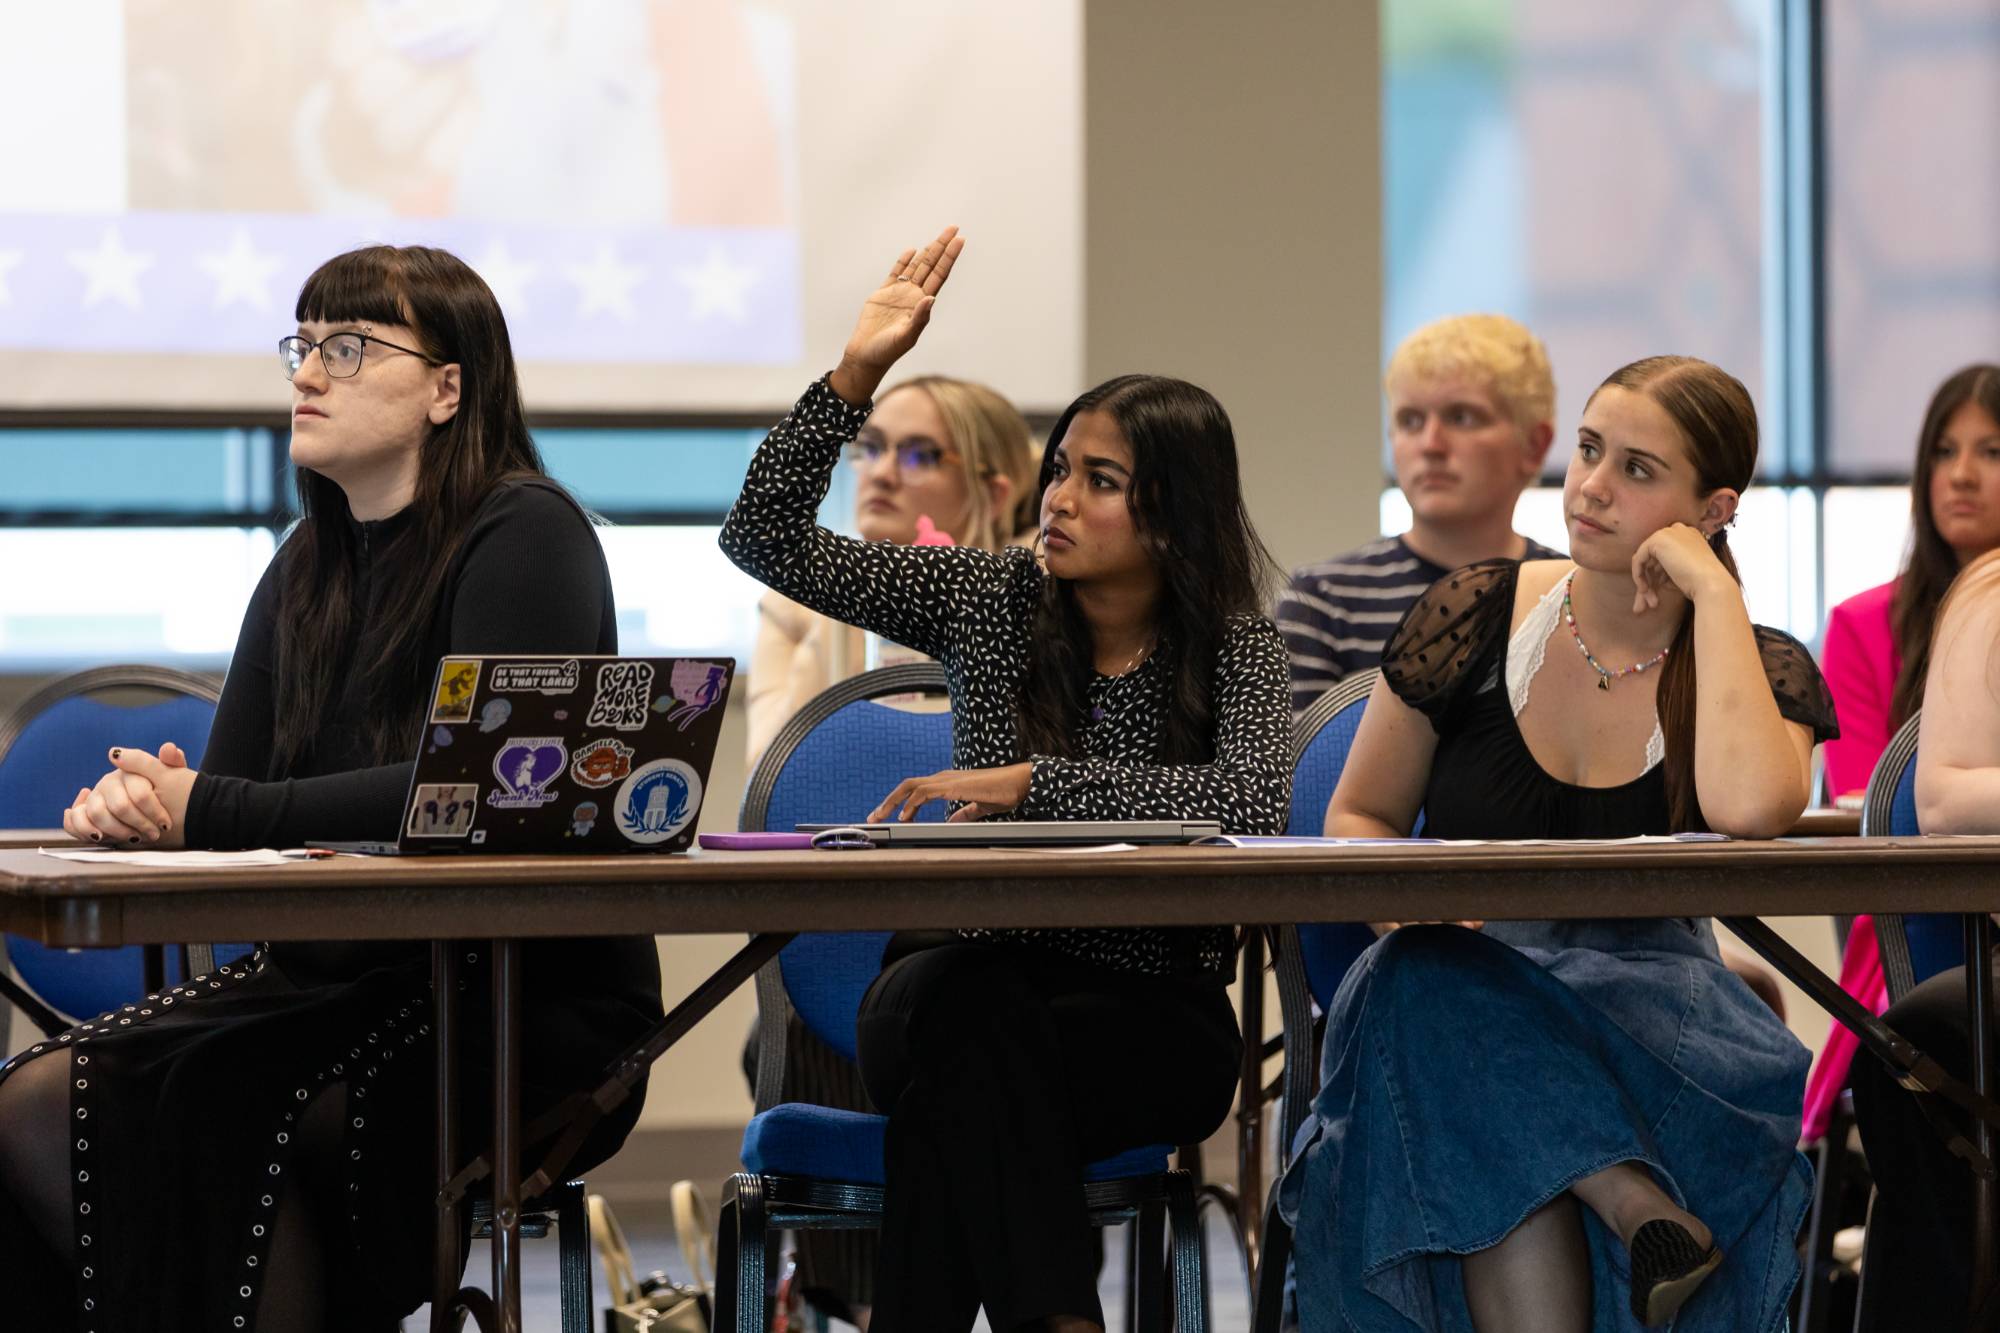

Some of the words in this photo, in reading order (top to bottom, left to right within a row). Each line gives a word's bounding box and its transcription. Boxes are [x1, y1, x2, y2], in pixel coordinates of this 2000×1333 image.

[495, 677, 509, 688] BE
[511, 677, 540, 688] THAT
[541, 676, 575, 687] LAKER
[497, 668, 507, 677] BE
[509, 668, 531, 677] THAT
[597, 681, 650, 708] MORE
[574, 739, 614, 759] GARFIELD
[636, 773, 664, 791] STUDENT
[665, 773, 685, 789] SENATE
[410, 799, 476, 830] 1989
